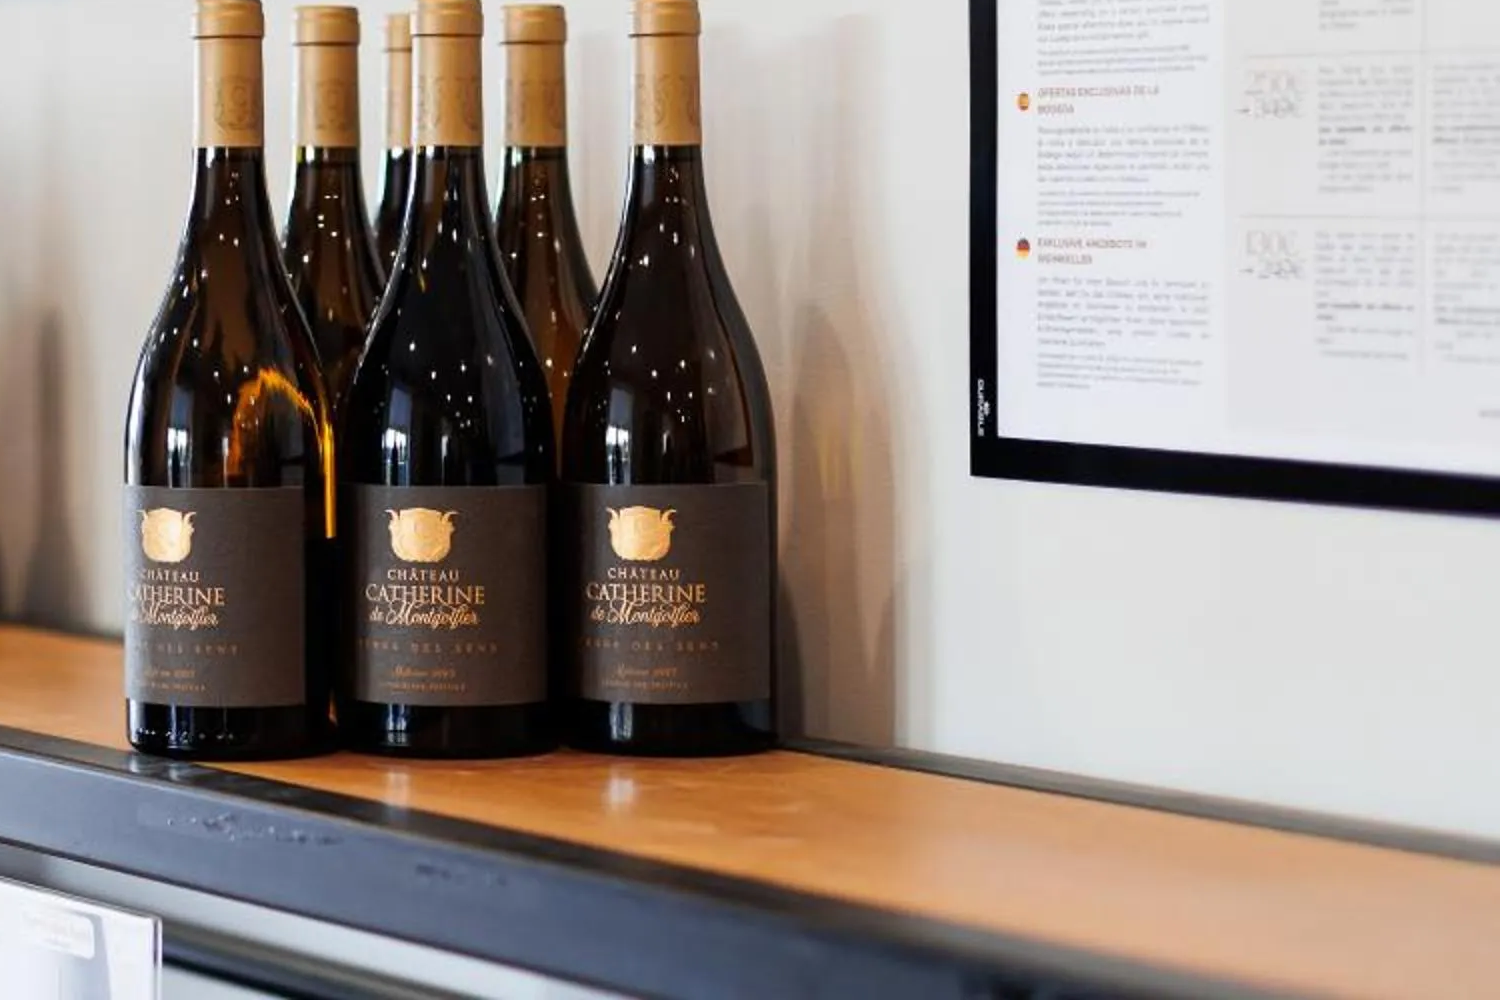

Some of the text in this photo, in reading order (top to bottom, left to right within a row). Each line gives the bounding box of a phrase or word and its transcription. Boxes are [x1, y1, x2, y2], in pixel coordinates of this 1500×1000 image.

[387, 567, 459, 581] CHÂTEAU
[607, 566, 680, 580] CHÂTEAU
[365, 583, 485, 605] CATHERINE
[586, 582, 706, 603] CATHERINE
[368, 601, 479, 630] de Montgolfier
[606, 600, 700, 628] Montgolfier
